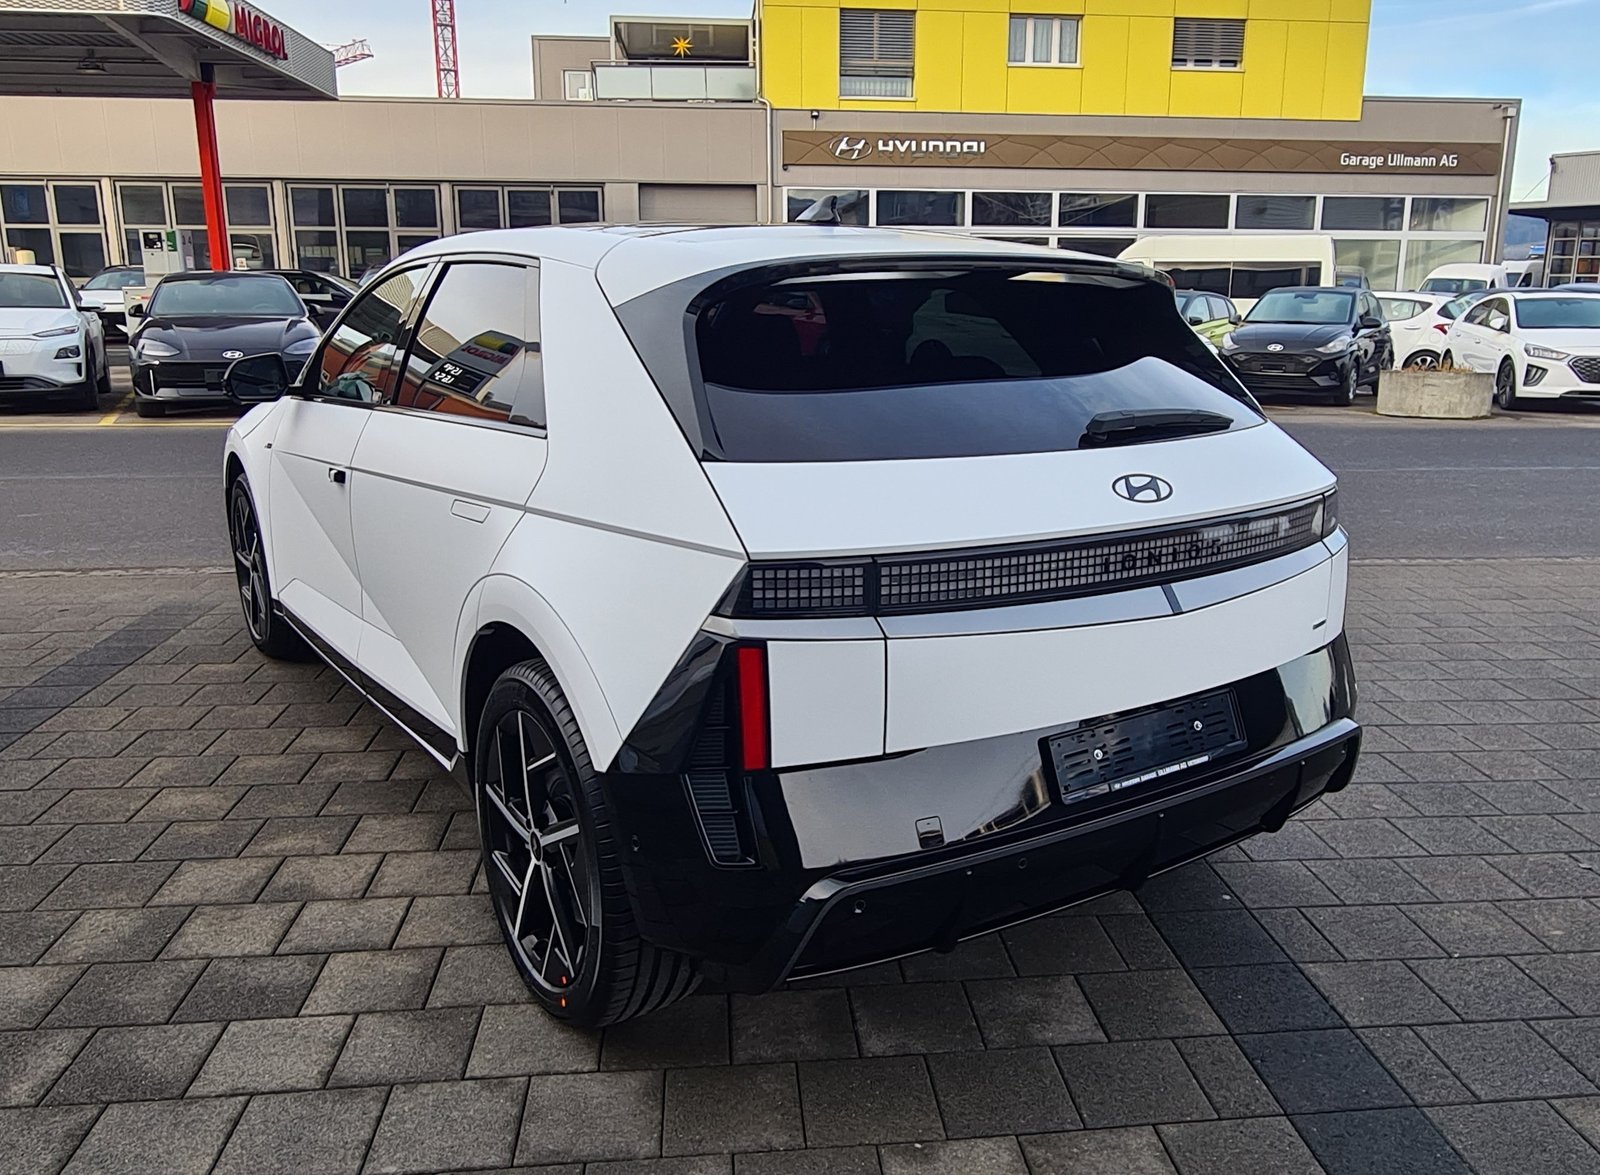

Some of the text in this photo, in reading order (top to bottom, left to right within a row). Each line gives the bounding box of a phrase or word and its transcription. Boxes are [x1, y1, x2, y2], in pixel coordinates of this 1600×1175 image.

[234, 1, 288, 60] MIGROL
[878, 140, 985, 153] HYUNDAI
[1340, 153, 1458, 169] Garage Ullmann AG
